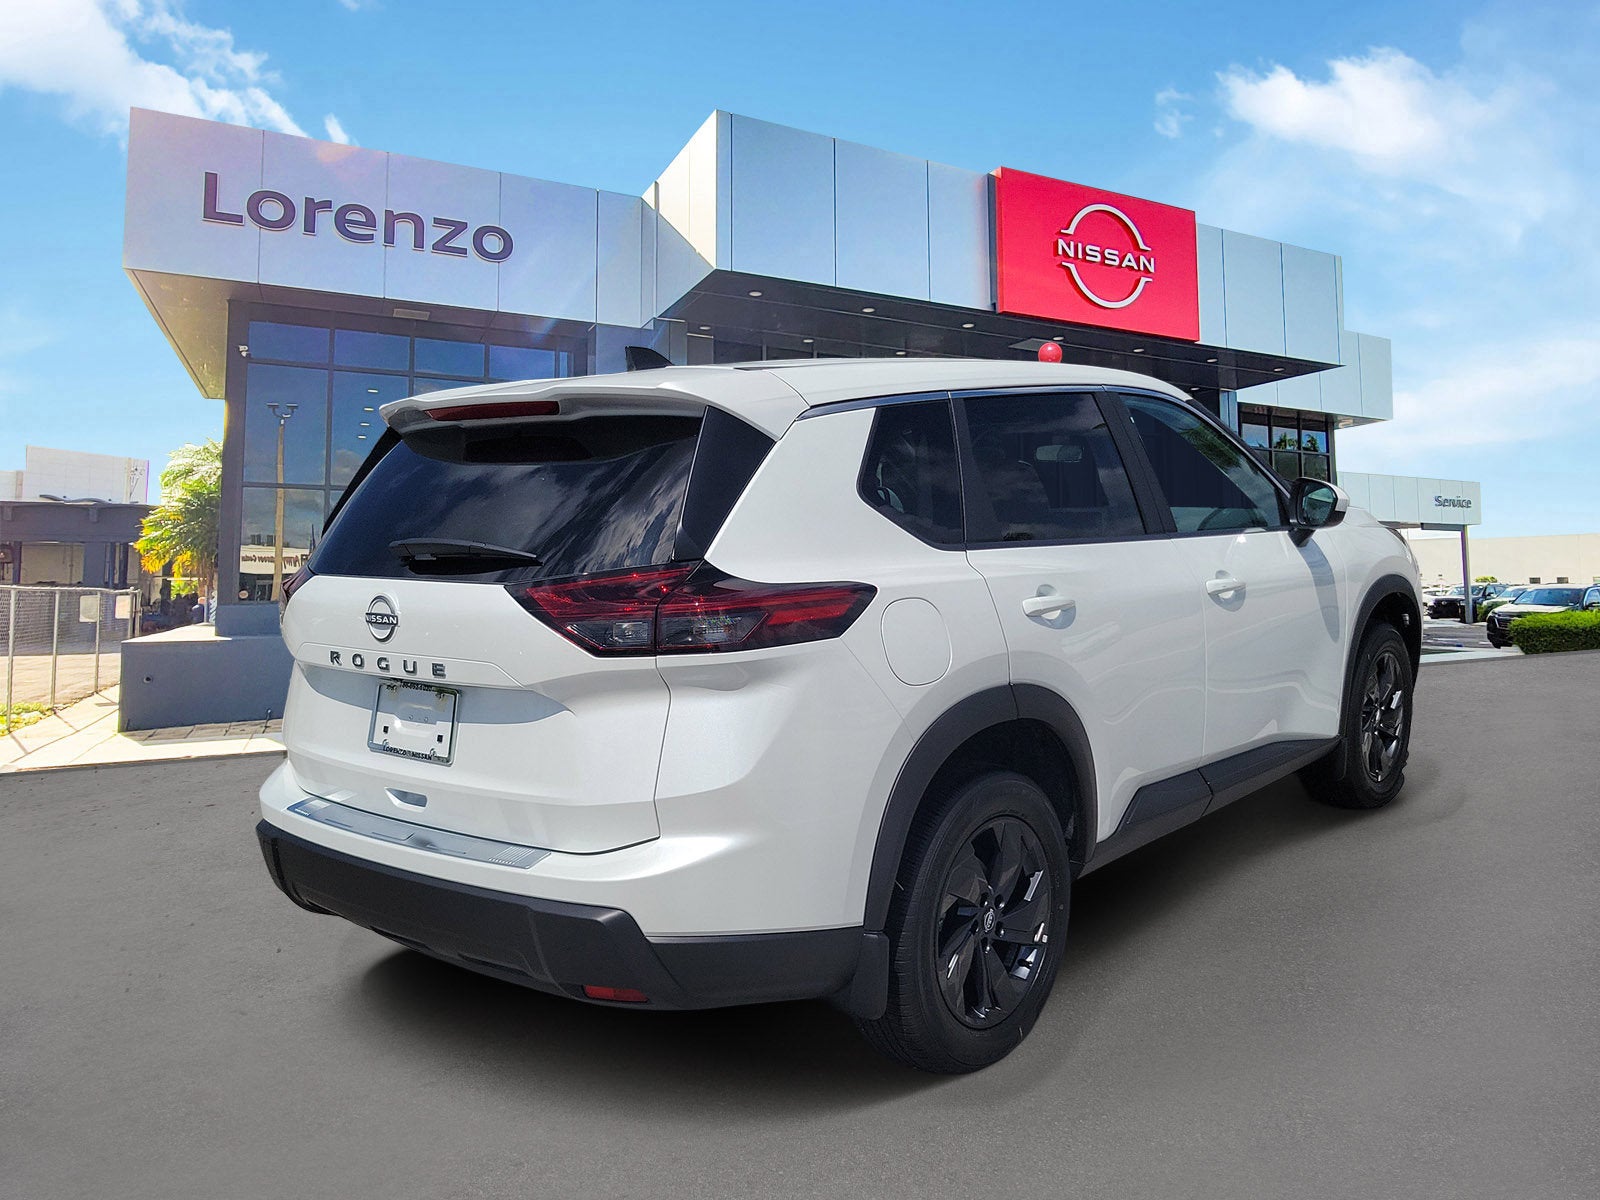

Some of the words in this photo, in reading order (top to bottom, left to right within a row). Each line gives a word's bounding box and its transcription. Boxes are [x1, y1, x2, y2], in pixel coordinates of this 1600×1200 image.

[202, 171, 515, 263] Lorenzo
[1057, 238, 1155, 274] NISSAN
[1434, 495, 1472, 508] Service
[365, 614, 397, 624] NISSAN
[330, 650, 446, 678] ROGUE
[383, 745, 407, 756] LORENZO
[412, 751, 433, 761] NISSAN
